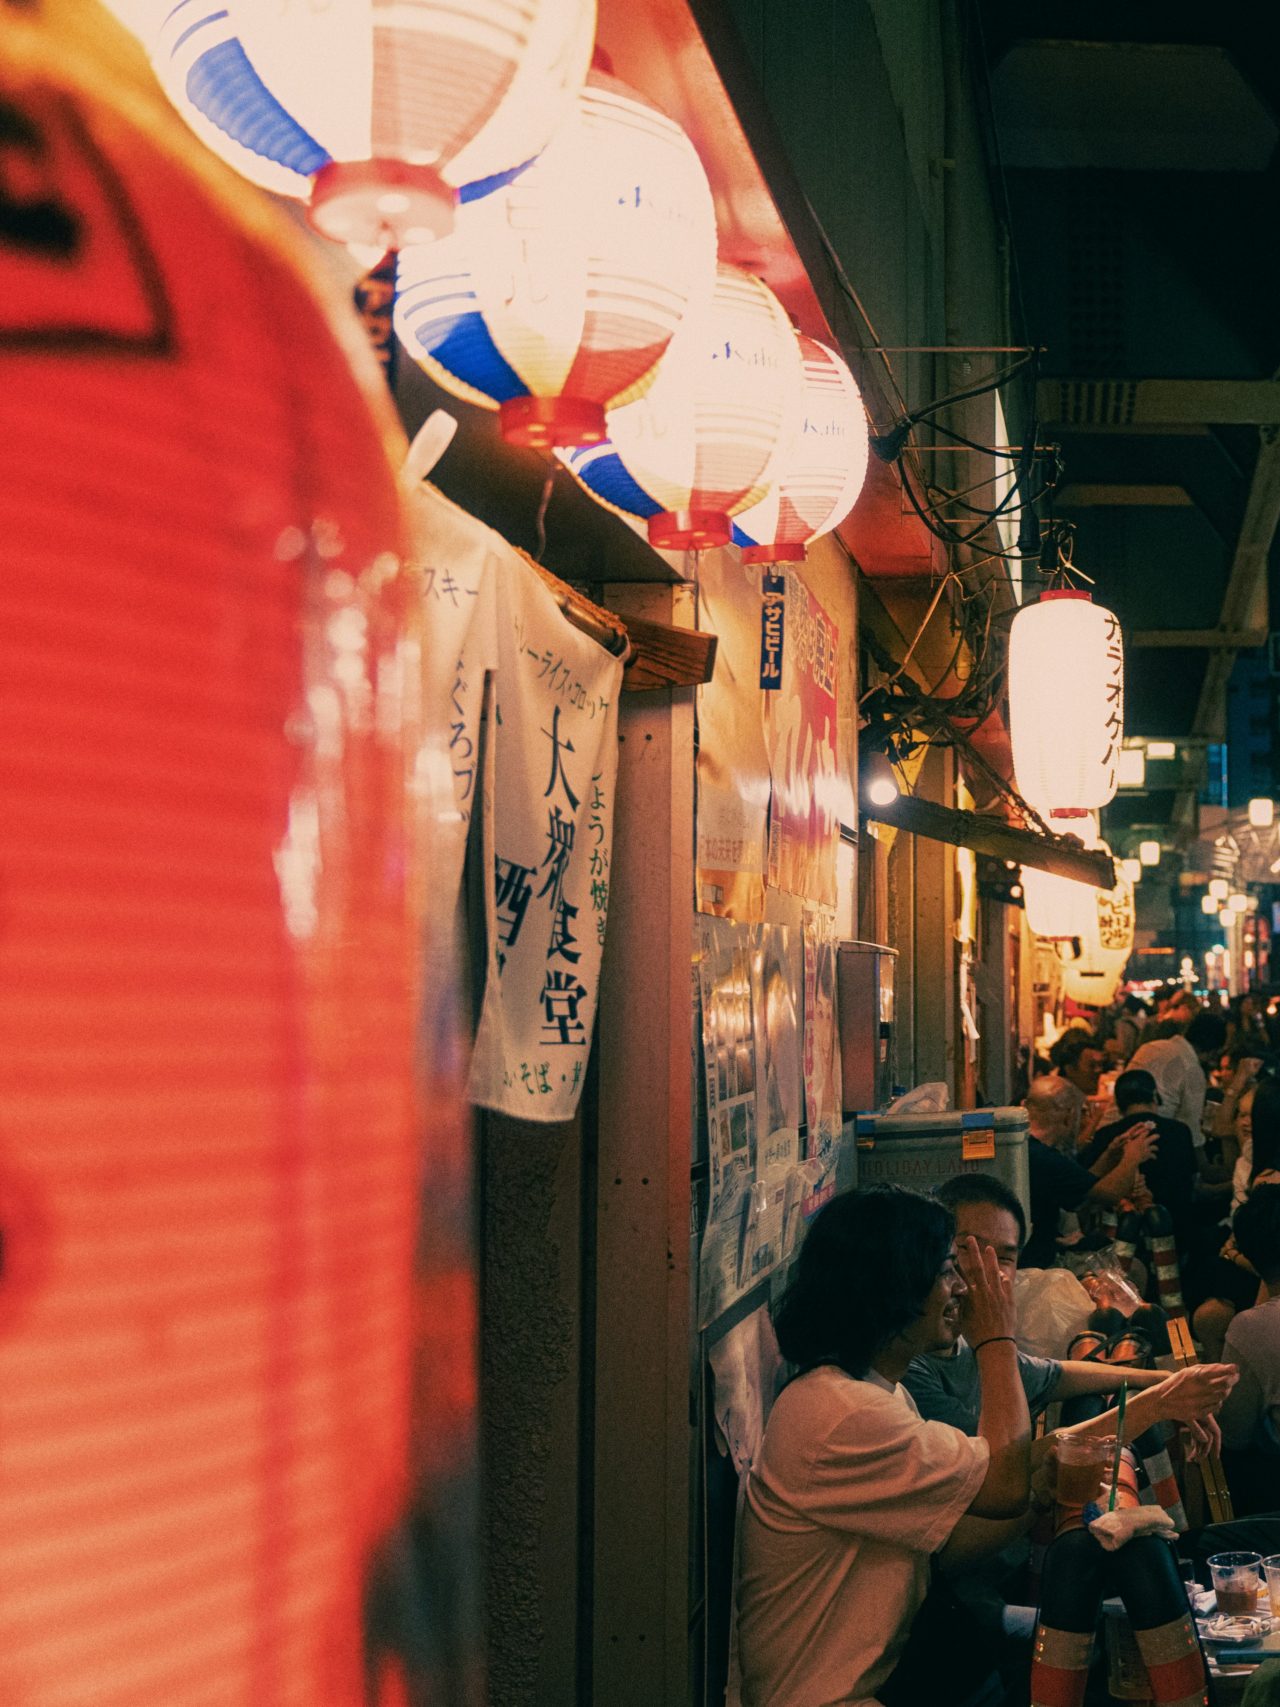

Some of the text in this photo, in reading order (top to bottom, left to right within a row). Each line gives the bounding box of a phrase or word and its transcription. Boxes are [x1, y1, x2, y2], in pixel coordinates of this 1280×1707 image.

[762, 591, 784, 678] アサヒビール
